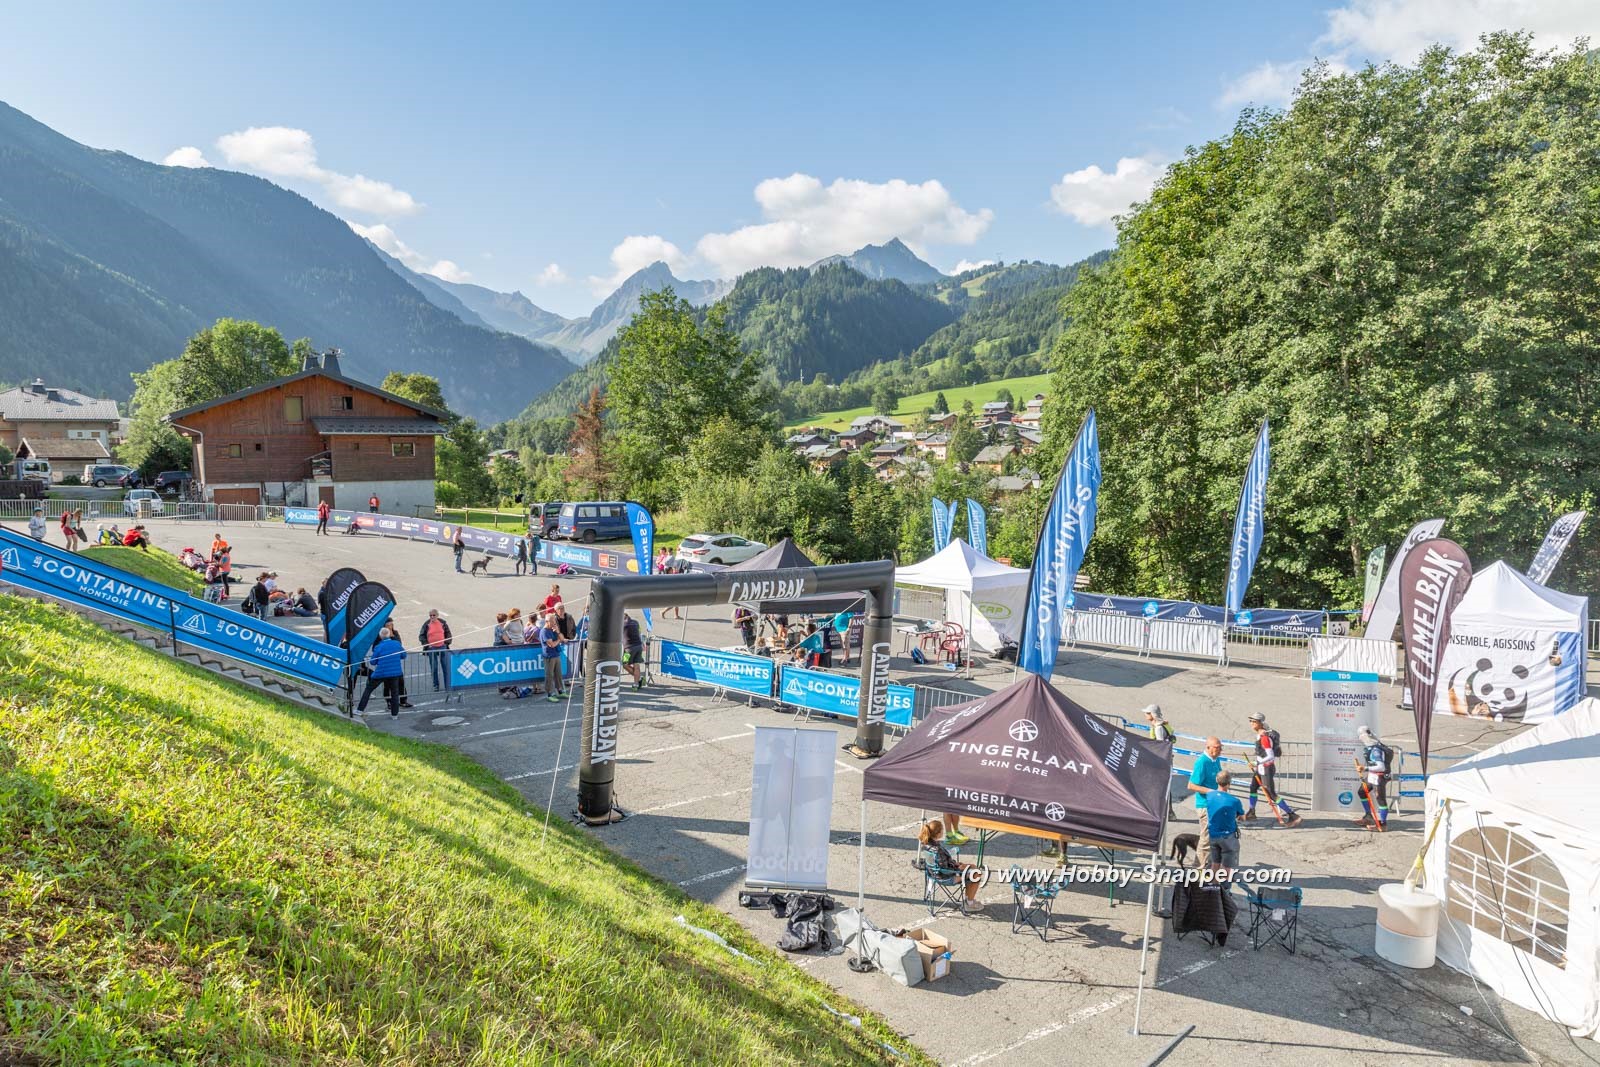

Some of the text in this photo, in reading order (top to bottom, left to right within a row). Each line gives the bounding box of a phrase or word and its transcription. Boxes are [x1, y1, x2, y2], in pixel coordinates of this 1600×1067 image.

[43, 560, 180, 613] CONTAMINES
[79, 585, 129, 607] MONTJOIE
[728, 578, 804, 603] CAMELBAK
[354, 595, 388, 628] CAMELBAK
[1411, 548, 1463, 686] CAMELBAK
[225, 623, 341, 670] CONTAMINES
[255, 646, 298, 665] MONTJOIE
[1450, 635, 1536, 651] NSEMBLE, AGISSONS
[478, 653, 544, 675] Columb
[690, 654, 770, 680] CONTAMINES
[711, 669, 740, 681] MONTJOIE
[866, 643, 891, 725] CAMELBAK
[840, 698, 860, 708] MONT
[1327, 693, 1378, 701] CONTAMINES
[591, 661, 621, 764] CAMELBAK
[948, 741, 1093, 775] TINGERLAAT
[980, 759, 1049, 777] SKIN CARE
[945, 787, 1040, 813] TINGERLAAT
[967, 804, 1011, 818] SKIN CARE
